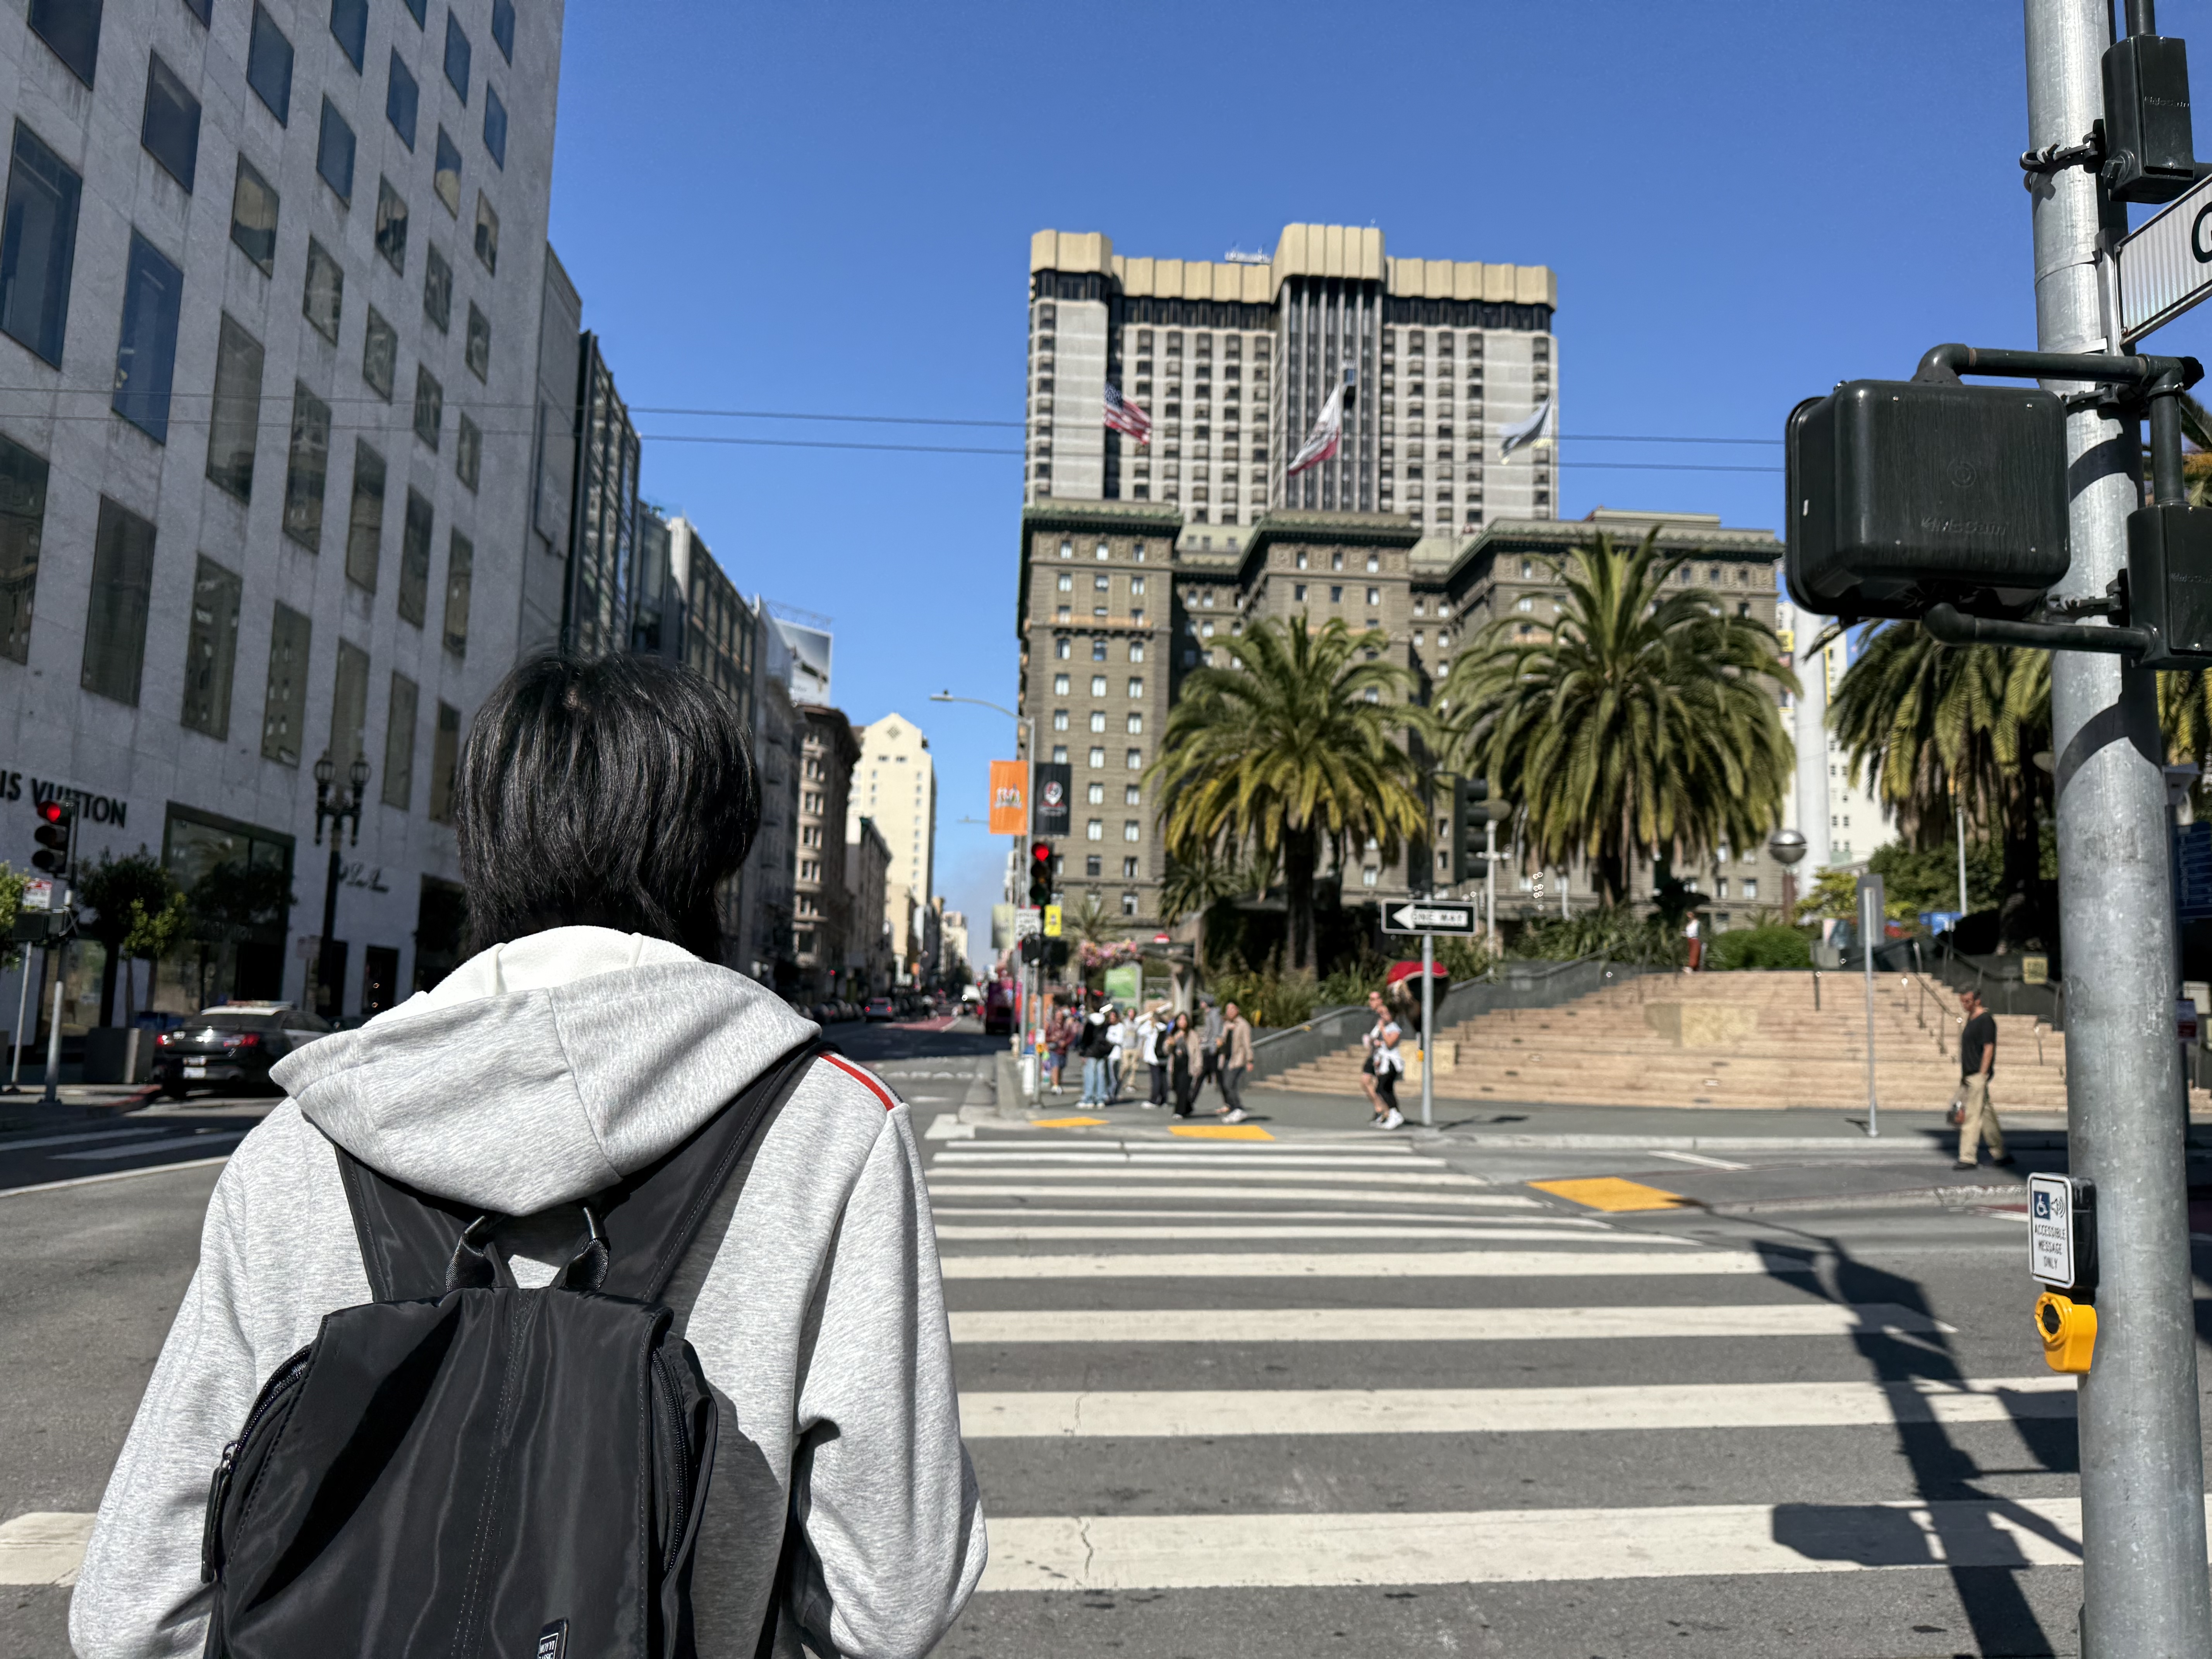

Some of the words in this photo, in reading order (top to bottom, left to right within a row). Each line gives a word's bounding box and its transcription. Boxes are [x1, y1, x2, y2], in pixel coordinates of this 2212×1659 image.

[0, 769, 22, 800] IS
[31, 778, 127, 829] VUTON
[2034, 1224, 2066, 1240] ACCESSIBLE
[2038, 1240, 2063, 1255] MESSAGE
[2044, 1256, 2058, 1270] ONLY
